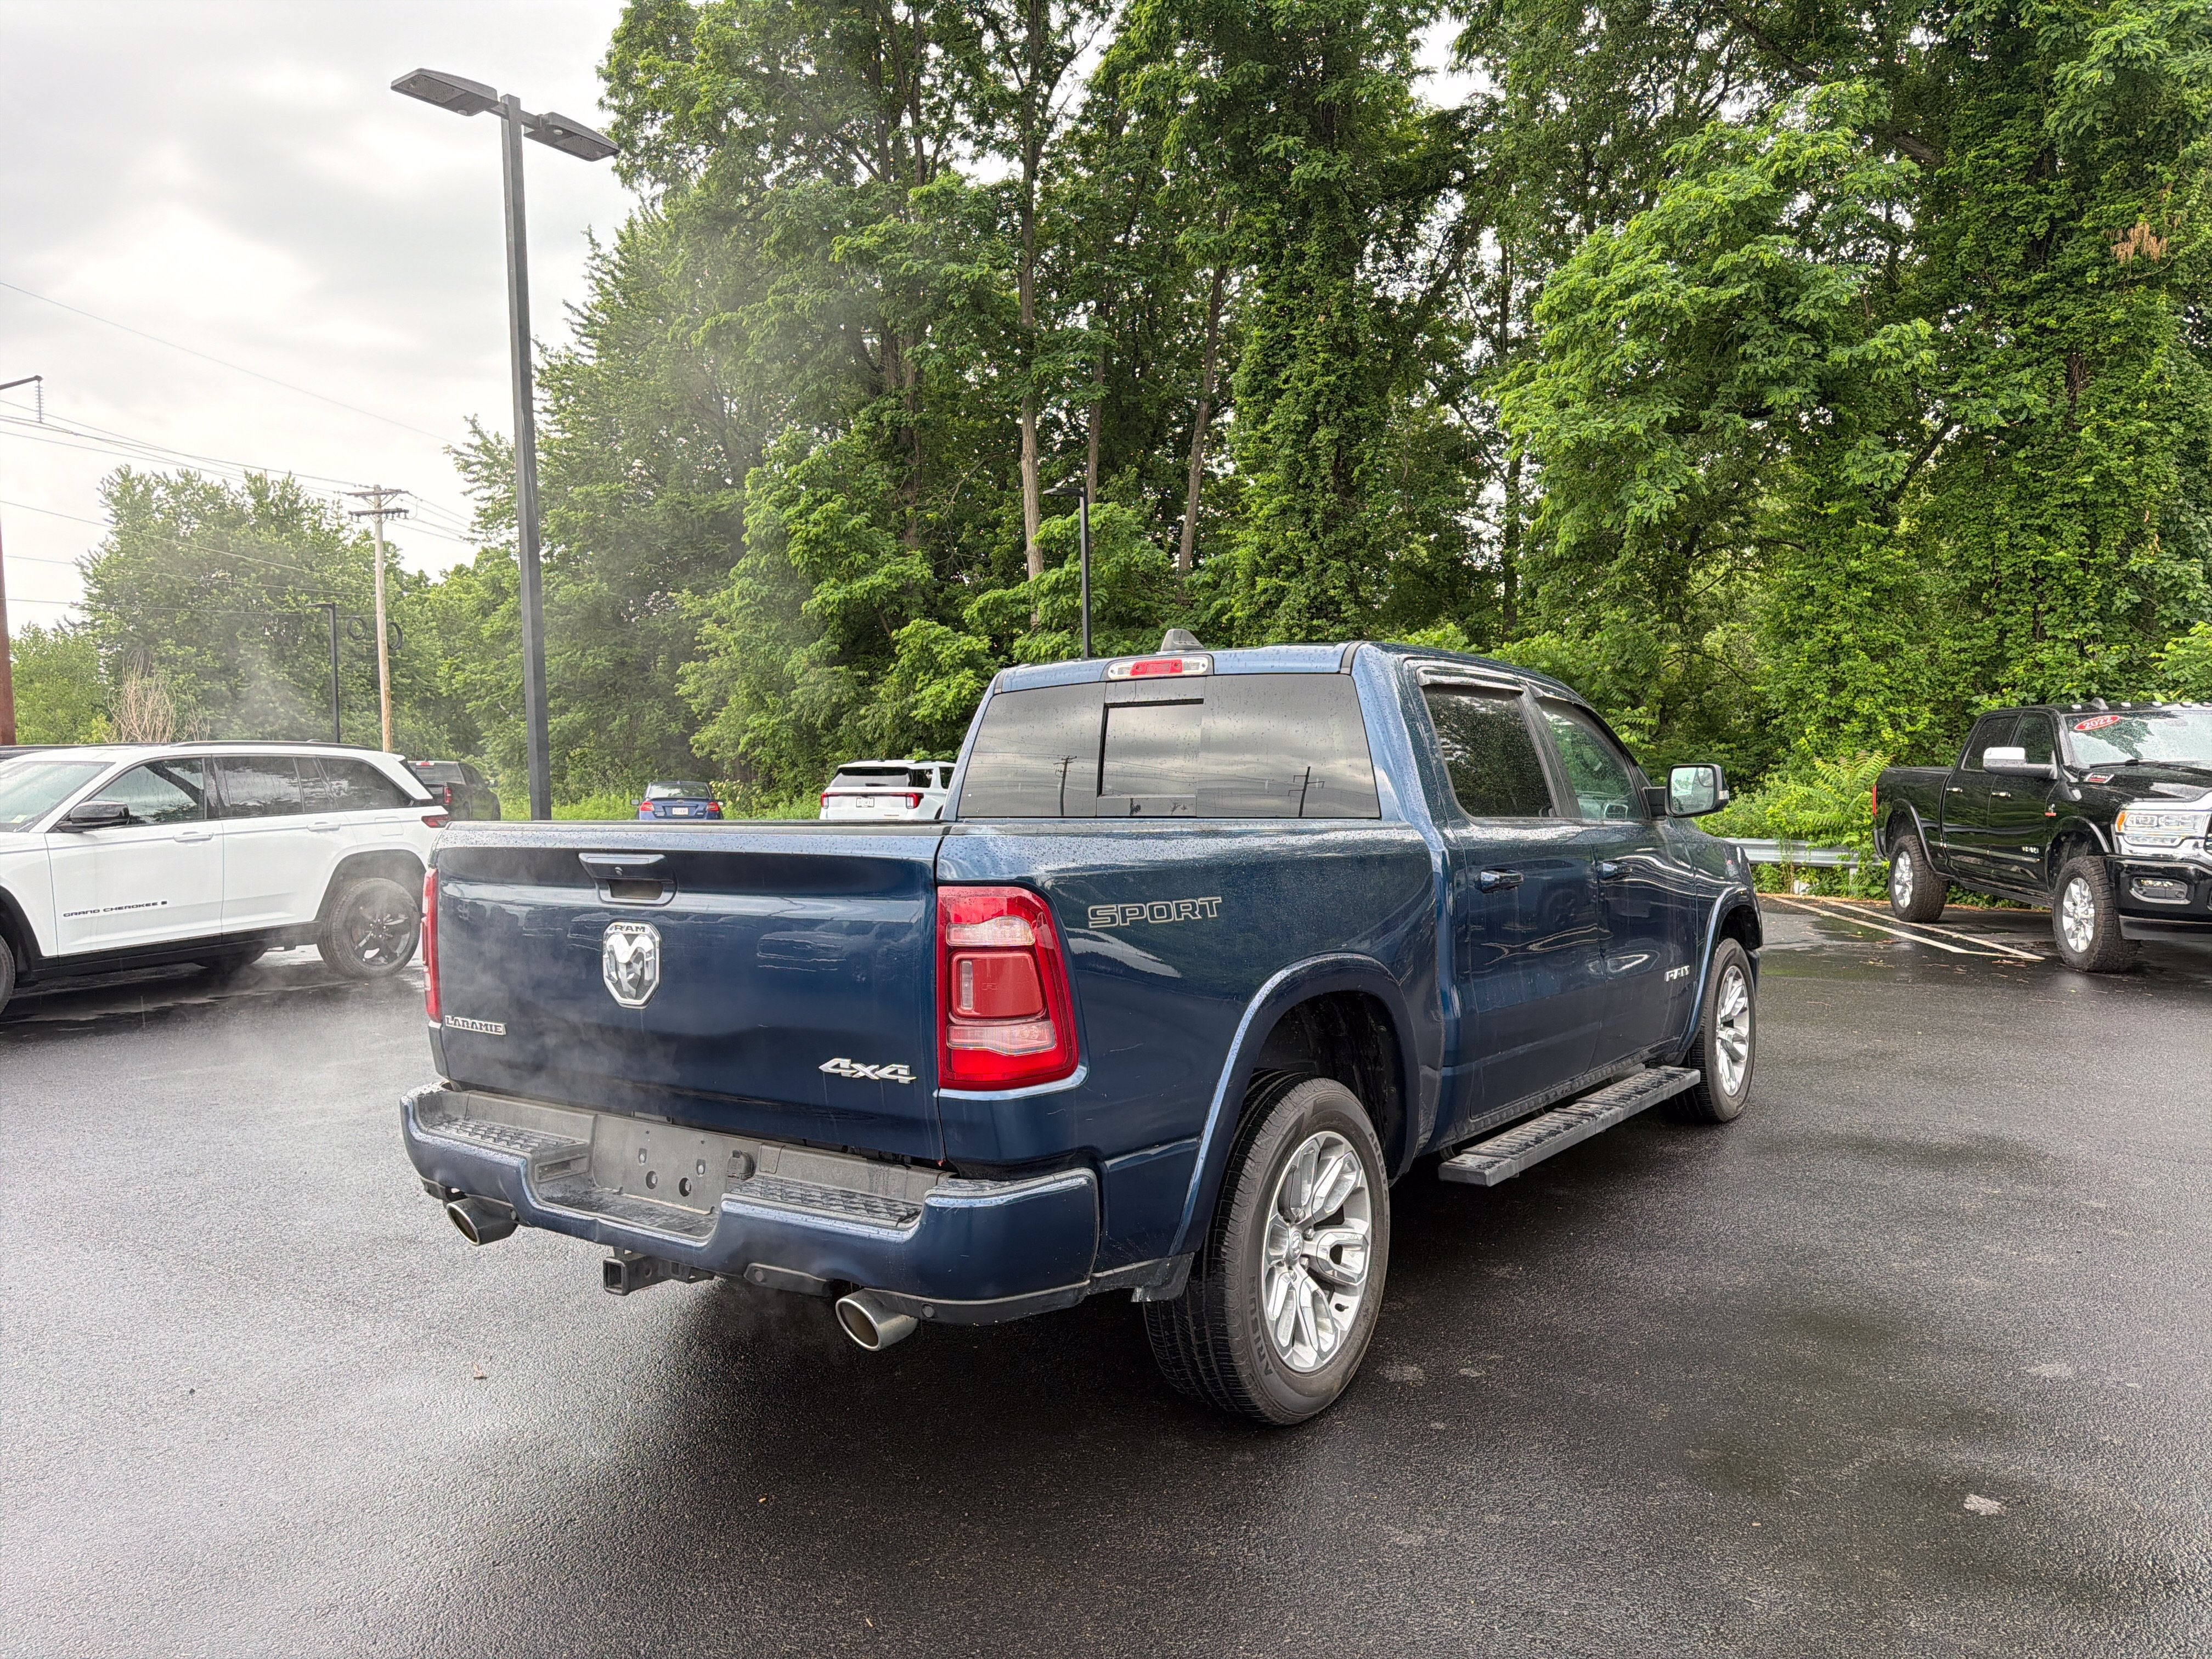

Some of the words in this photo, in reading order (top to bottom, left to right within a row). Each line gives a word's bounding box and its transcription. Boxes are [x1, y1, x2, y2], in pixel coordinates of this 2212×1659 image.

[2083, 716, 2113, 728] 2022
[63, 909, 100, 917] GRAND
[103, 902, 158, 912] CHEROKEE
[1088, 896, 1222, 928] SPORT
[445, 1015, 505, 1035] LARAMIE
[1249, 1276, 1273, 1376] ARISUN
